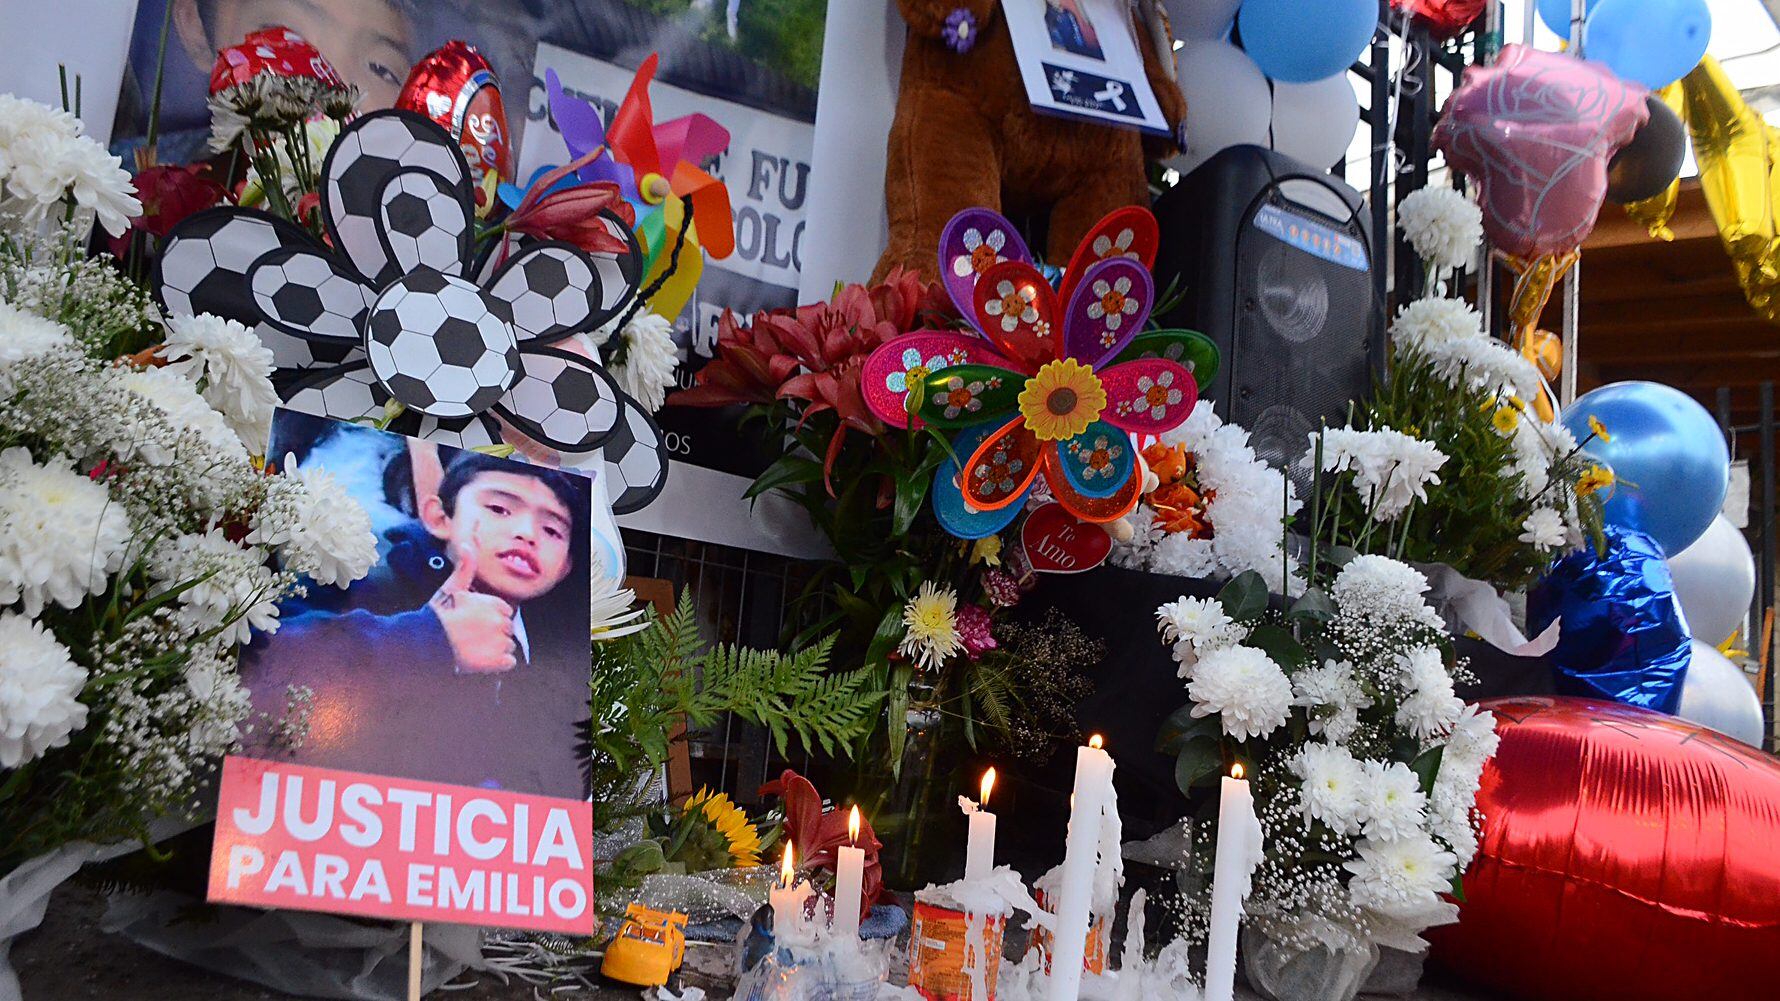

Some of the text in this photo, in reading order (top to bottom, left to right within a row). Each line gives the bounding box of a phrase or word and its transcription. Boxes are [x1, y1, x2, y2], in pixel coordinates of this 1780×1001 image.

[1030, 534, 1075, 568] Amo
[1058, 524, 1075, 542] Te
[233, 772, 584, 870] JUSTICIA
[226, 845, 587, 919] PARA EMILIO
